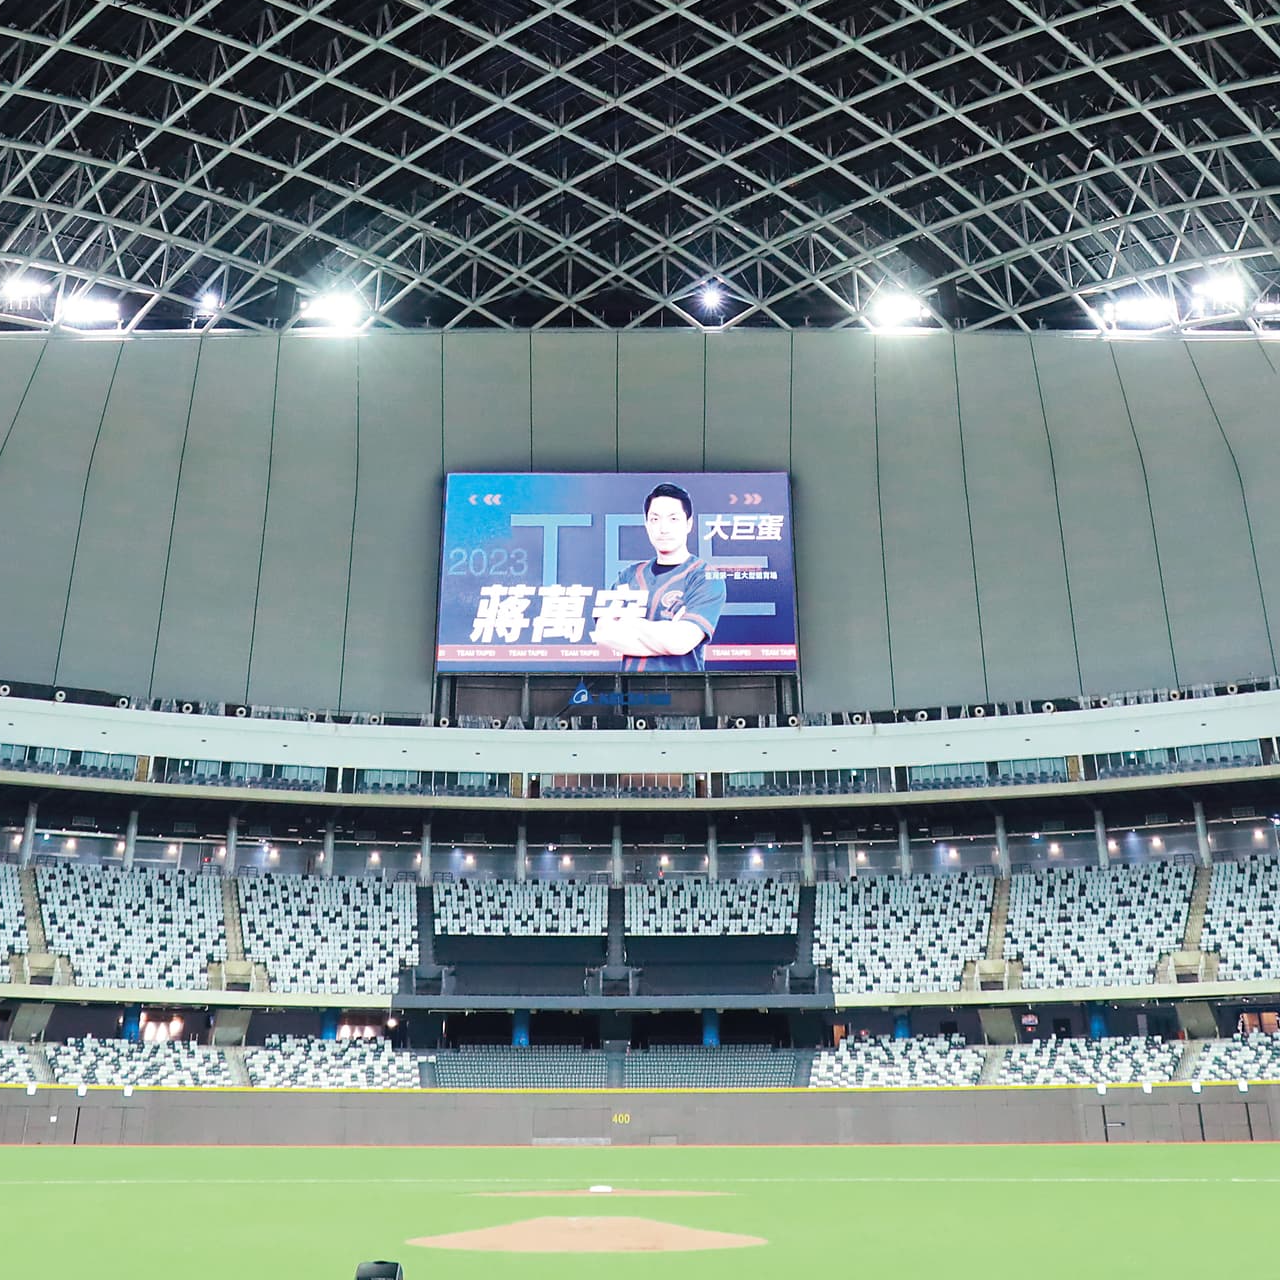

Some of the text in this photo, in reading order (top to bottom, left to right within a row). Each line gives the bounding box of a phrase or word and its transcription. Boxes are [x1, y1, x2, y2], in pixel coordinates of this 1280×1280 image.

[703, 514, 784, 541] 大巨蛋
[448, 548, 528, 576] 2023
[456, 649, 600, 657] TEAM TAIPEI TEAM TAIPEI TEAM TAIPEI
[612, 1113, 631, 1124] 400
